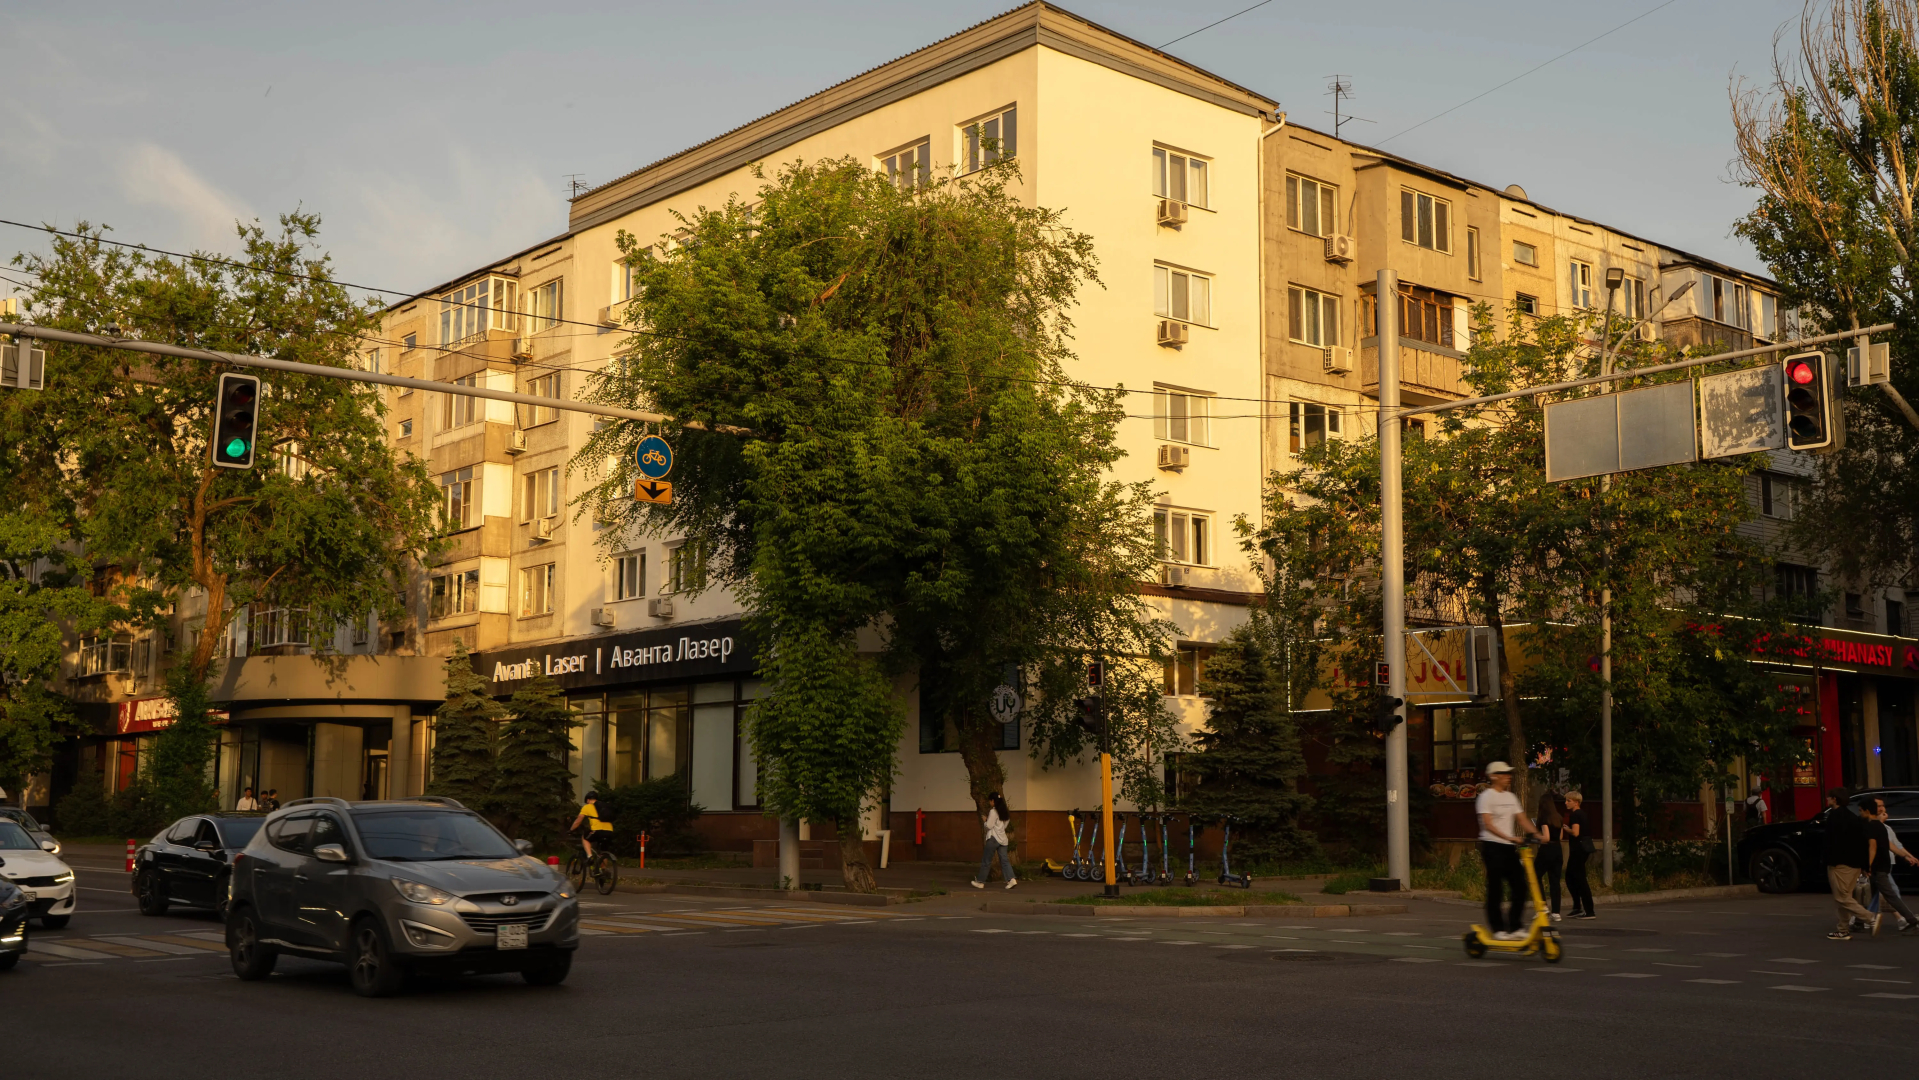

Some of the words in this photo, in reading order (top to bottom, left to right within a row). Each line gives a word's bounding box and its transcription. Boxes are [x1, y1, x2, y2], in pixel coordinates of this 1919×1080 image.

[545, 654, 588, 676] Laser
[610, 643, 673, 669] Аванта
[676, 636, 734, 663] Лазер
